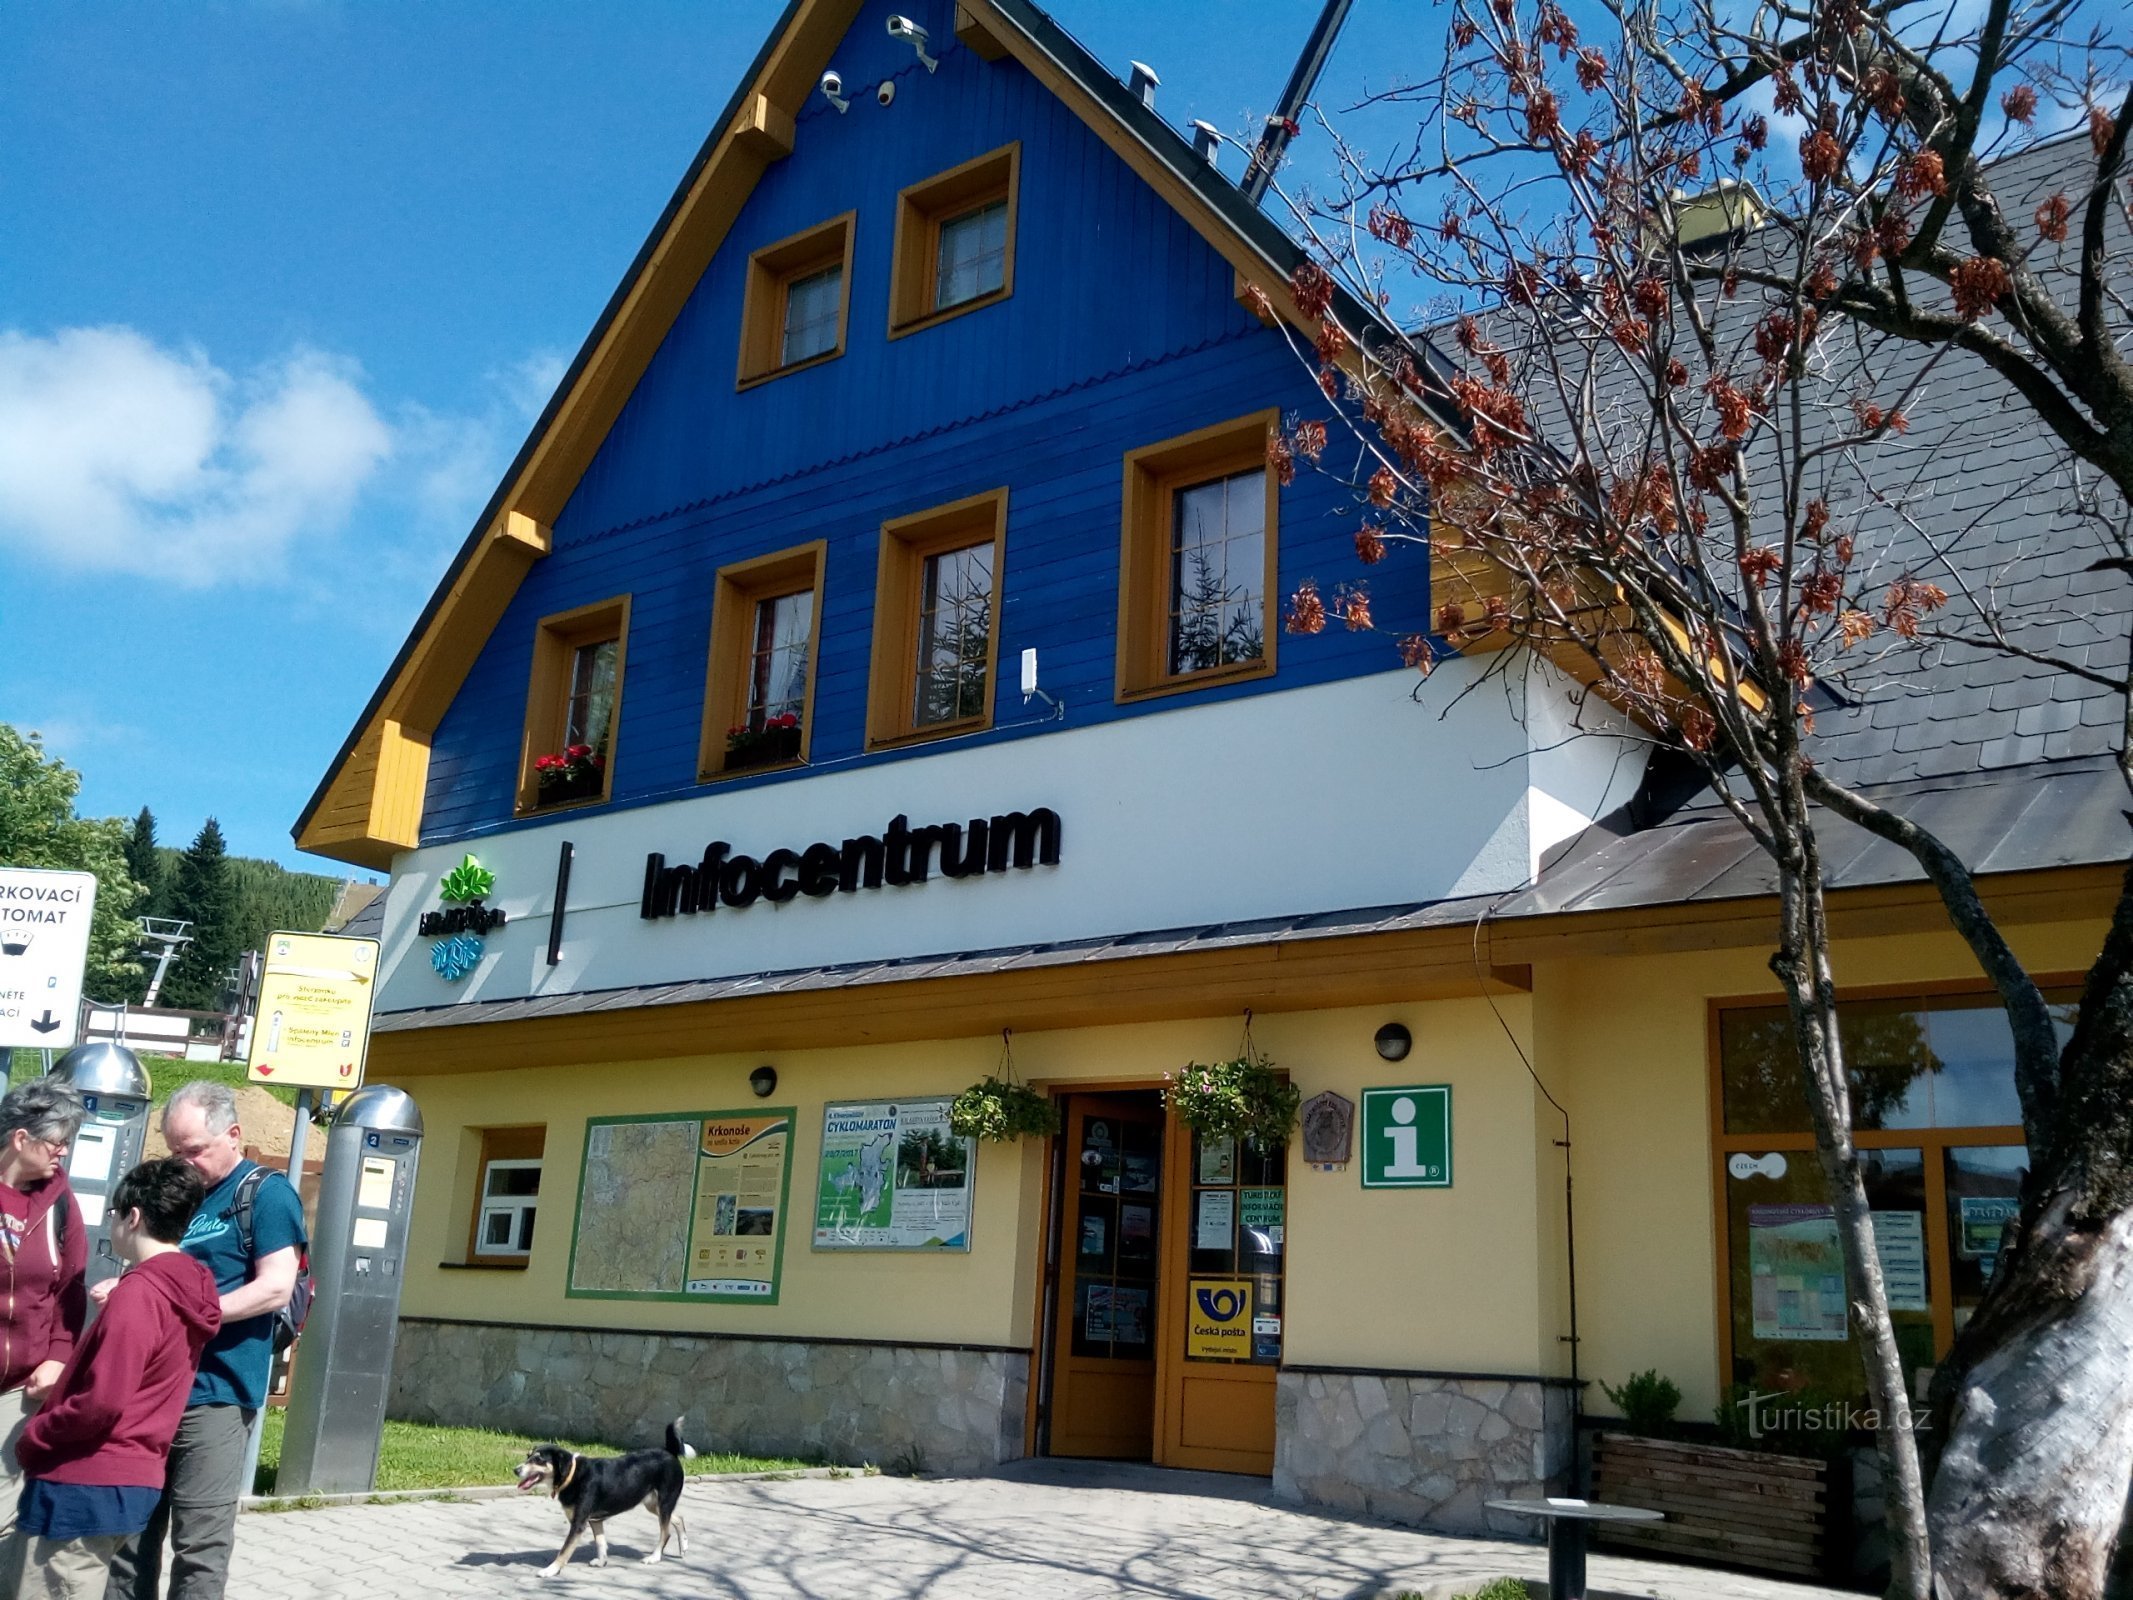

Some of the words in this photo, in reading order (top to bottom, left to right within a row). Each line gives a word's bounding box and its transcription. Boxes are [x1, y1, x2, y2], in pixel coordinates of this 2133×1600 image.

[640, 807, 1062, 920] Infocentrum
[708, 1124, 751, 1137] Krkonoše
[827, 1119, 897, 1133] CYKLOMARATON
[1194, 1324, 1220, 1336] Česká
[1221, 1327, 1246, 1338] pošta
